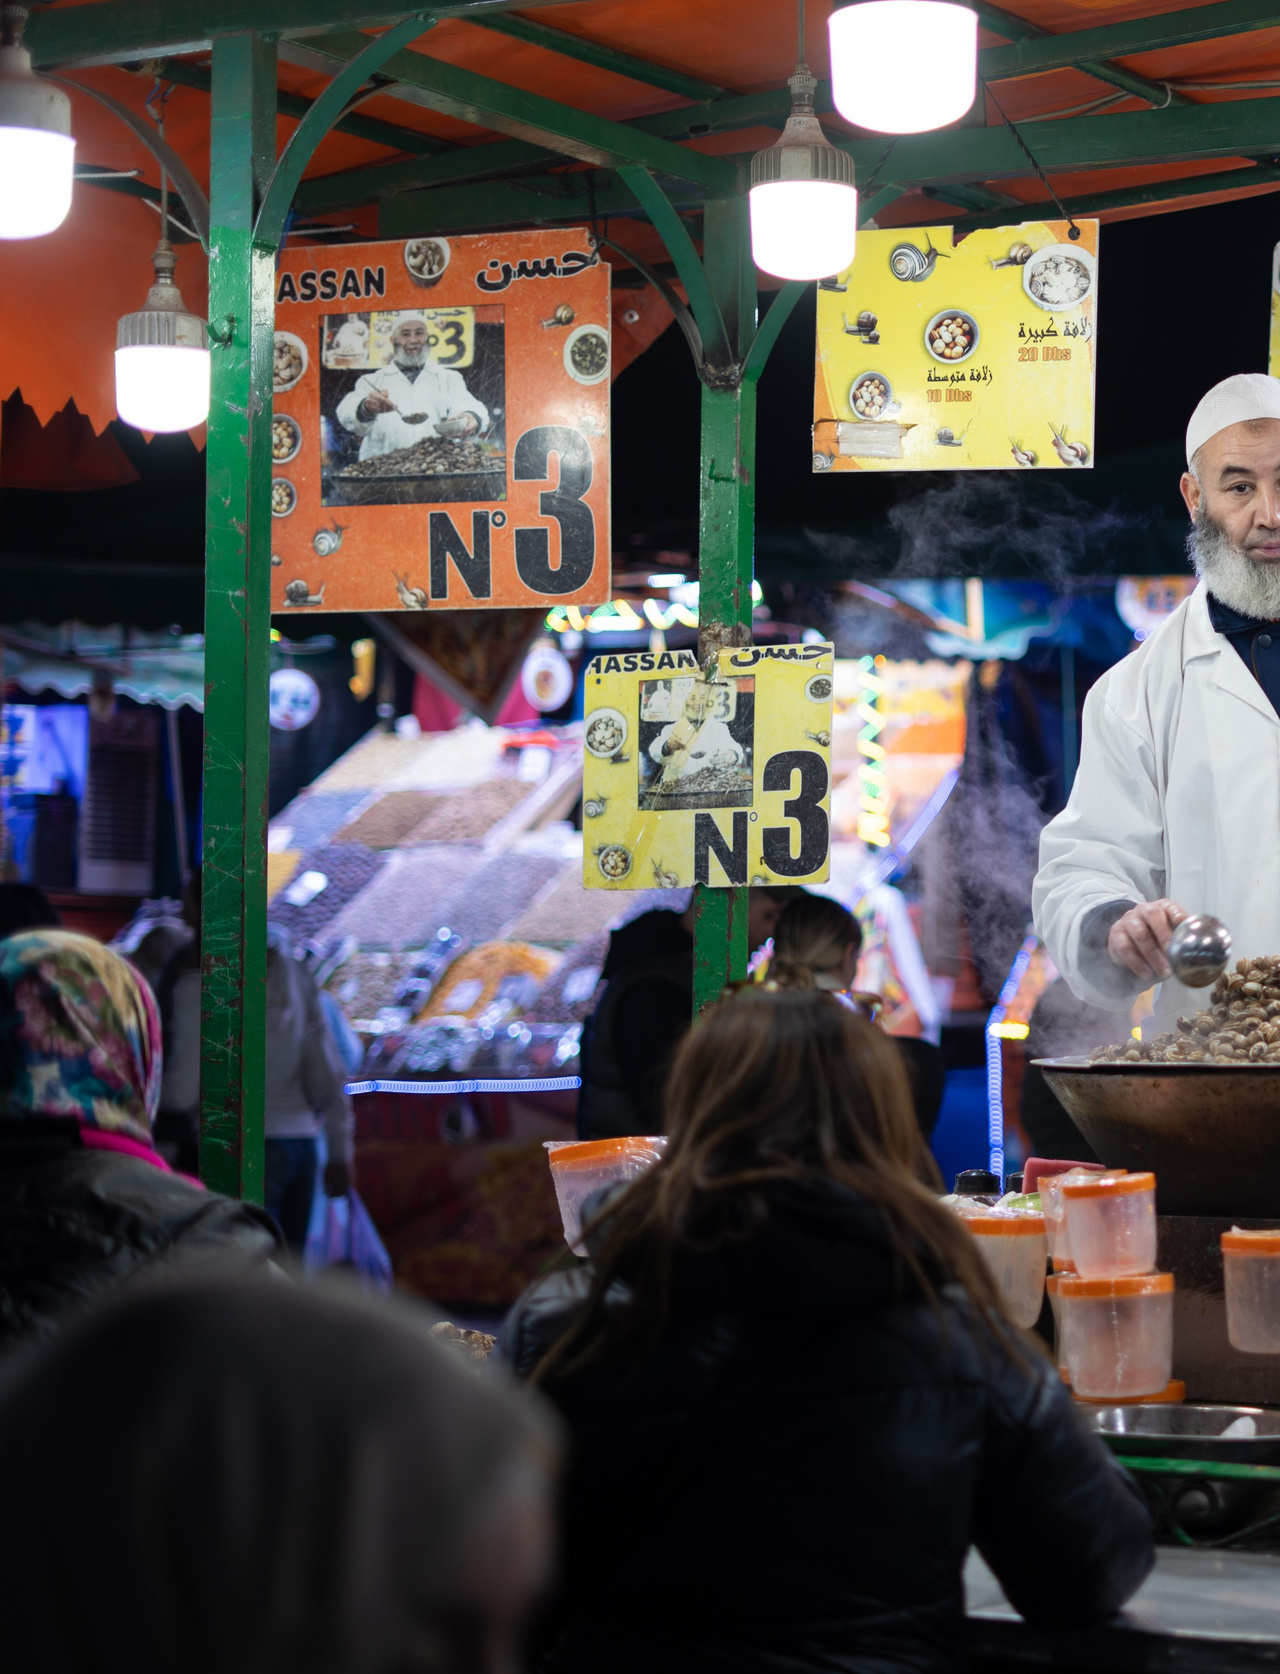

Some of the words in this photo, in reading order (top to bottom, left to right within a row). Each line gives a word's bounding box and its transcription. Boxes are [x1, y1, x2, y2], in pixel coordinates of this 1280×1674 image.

[476, 251, 598, 292] حسن
[276, 266, 384, 303] ASSAN
[1018, 316, 1058, 345] كبيرة
[438, 320, 467, 364] 3
[1018, 346, 1038, 362] 20
[1042, 346, 1072, 361] Dhs
[927, 366, 966, 387] متوسطة
[970, 365, 993, 386] زلافة
[927, 388, 942, 403] 10
[946, 388, 972, 402] Dhs
[730, 645, 832, 667] حسن
